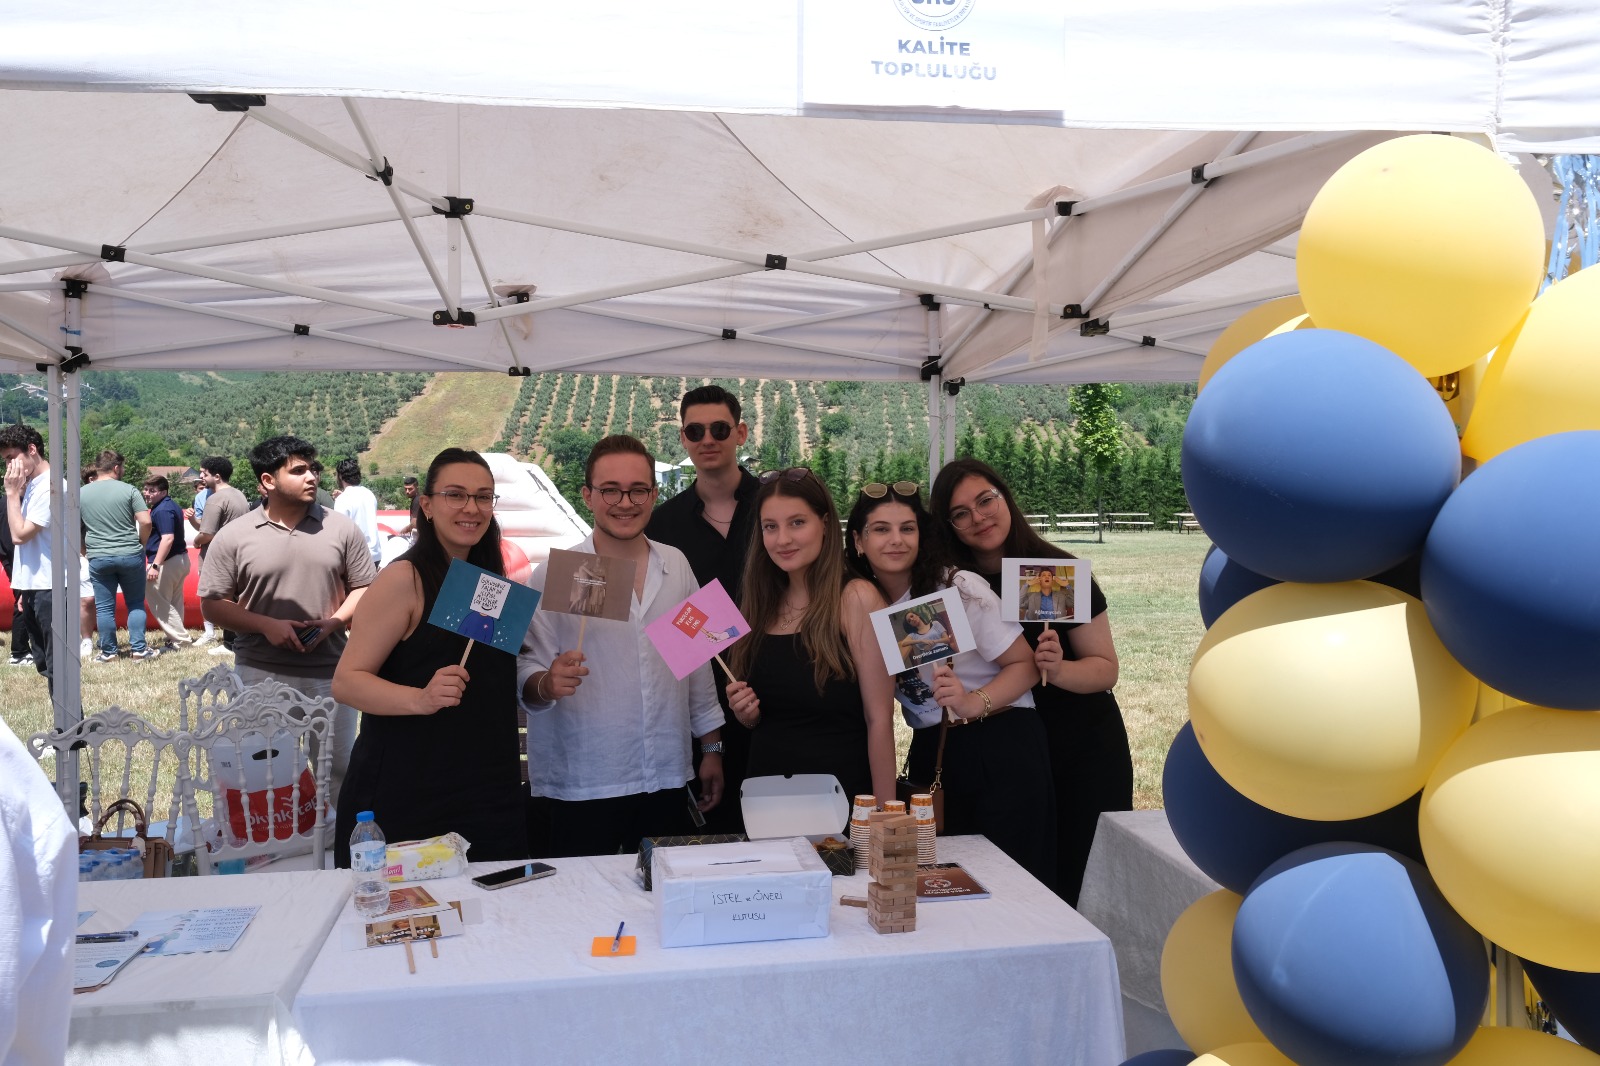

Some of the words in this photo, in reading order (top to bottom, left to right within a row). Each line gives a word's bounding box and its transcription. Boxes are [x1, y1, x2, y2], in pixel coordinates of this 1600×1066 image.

[898, 36, 970, 56] KALİTE
[870, 60, 997, 81] TOPLULUĞU
[712, 892, 742, 905] İSTEK
[753, 890, 783, 901] ÖNERİ
[732, 912, 766, 922] KUTUSU
